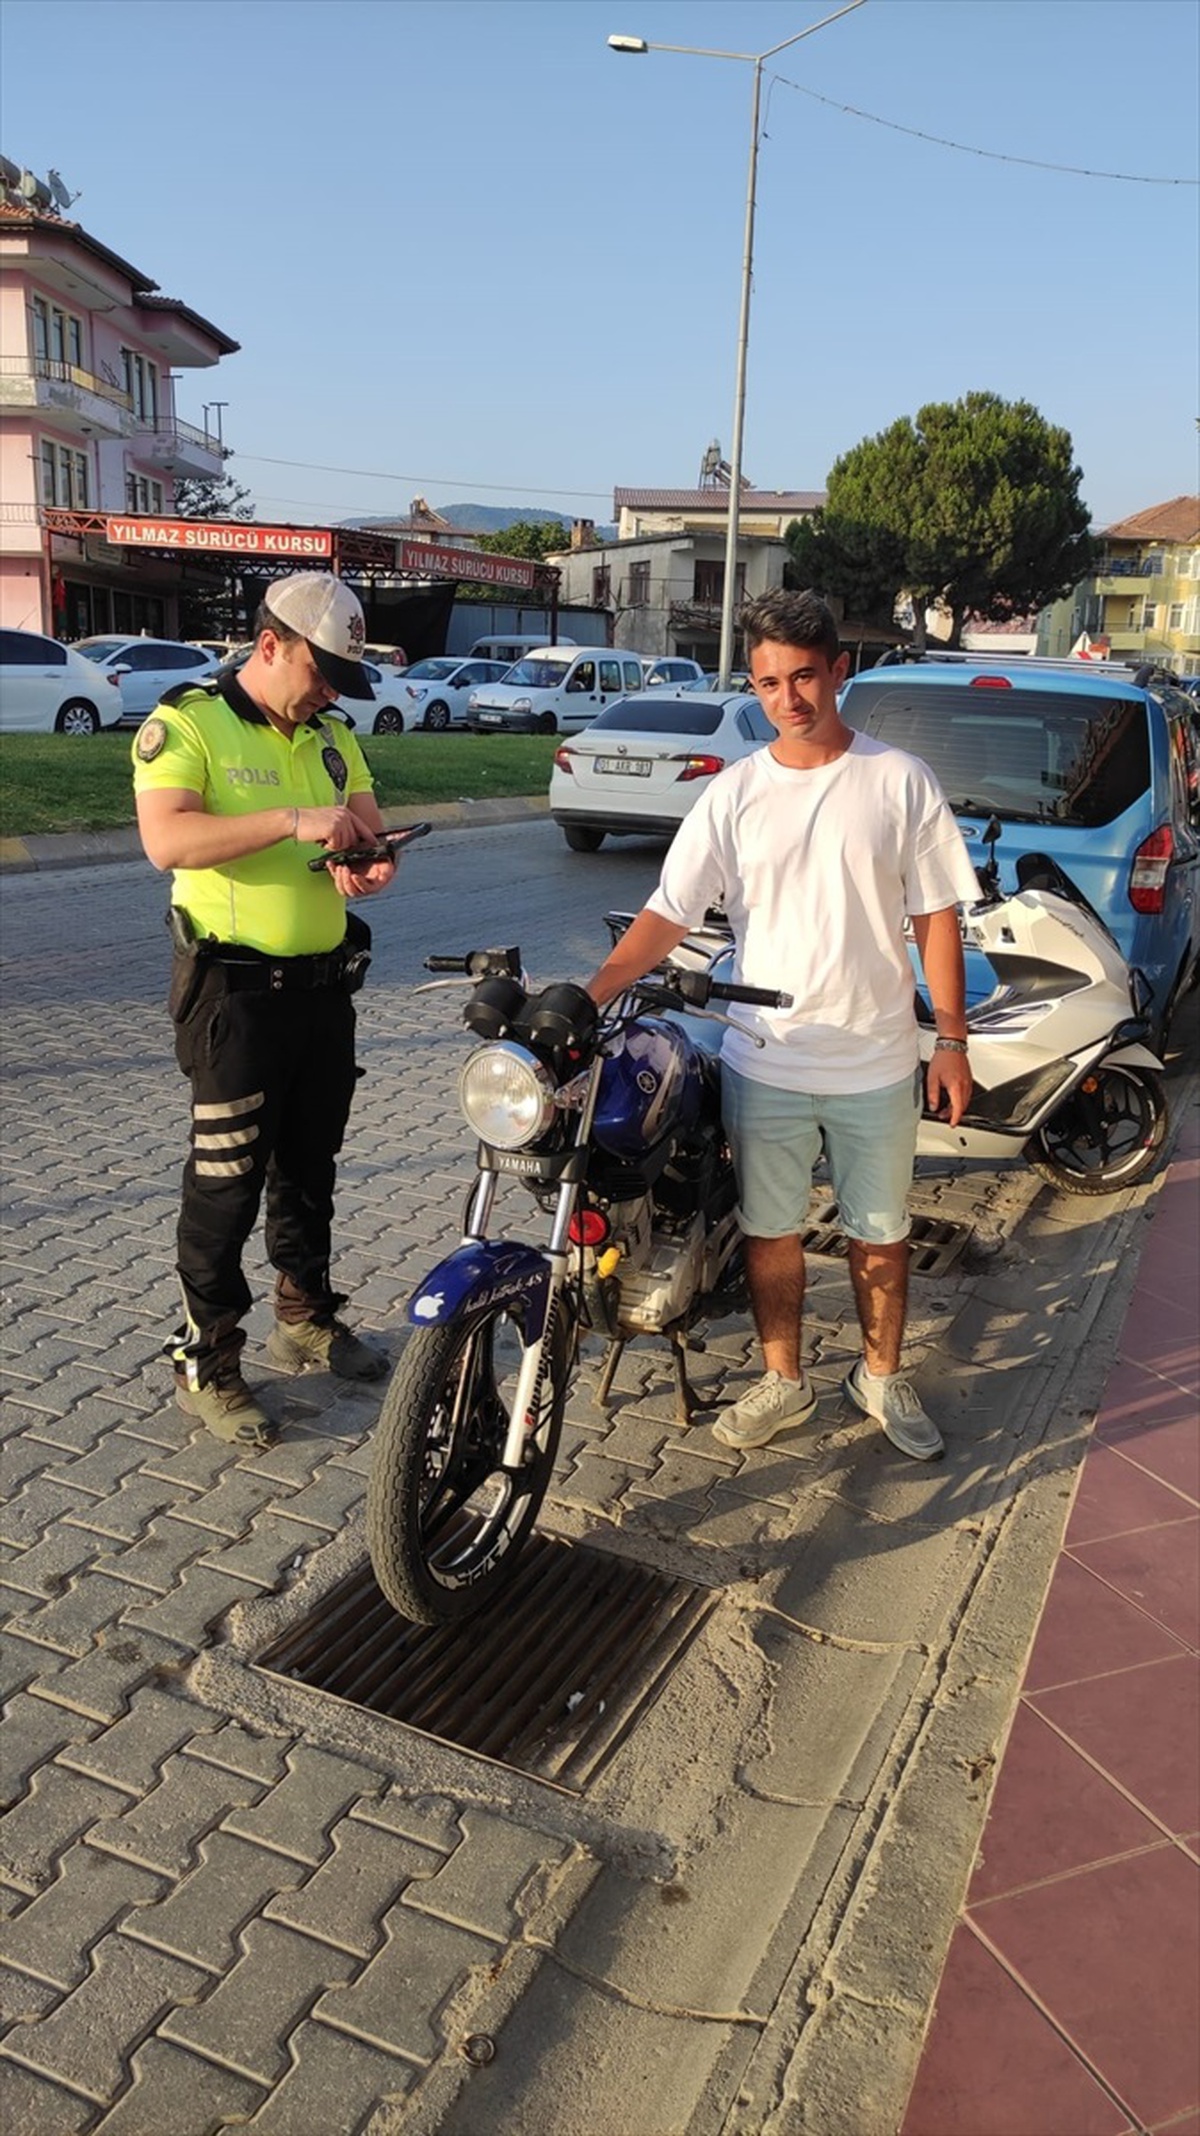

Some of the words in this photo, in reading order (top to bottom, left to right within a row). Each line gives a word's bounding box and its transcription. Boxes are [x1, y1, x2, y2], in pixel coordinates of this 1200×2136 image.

[113, 525, 179, 544] YILMAZ
[185, 528, 258, 549] SÜRÜCÜ
[264, 536, 326, 552] KURSU
[406, 549, 449, 573] YILMAZ
[496, 565, 530, 585] KURSU
[498, 1156, 541, 1174] YAMAHA
